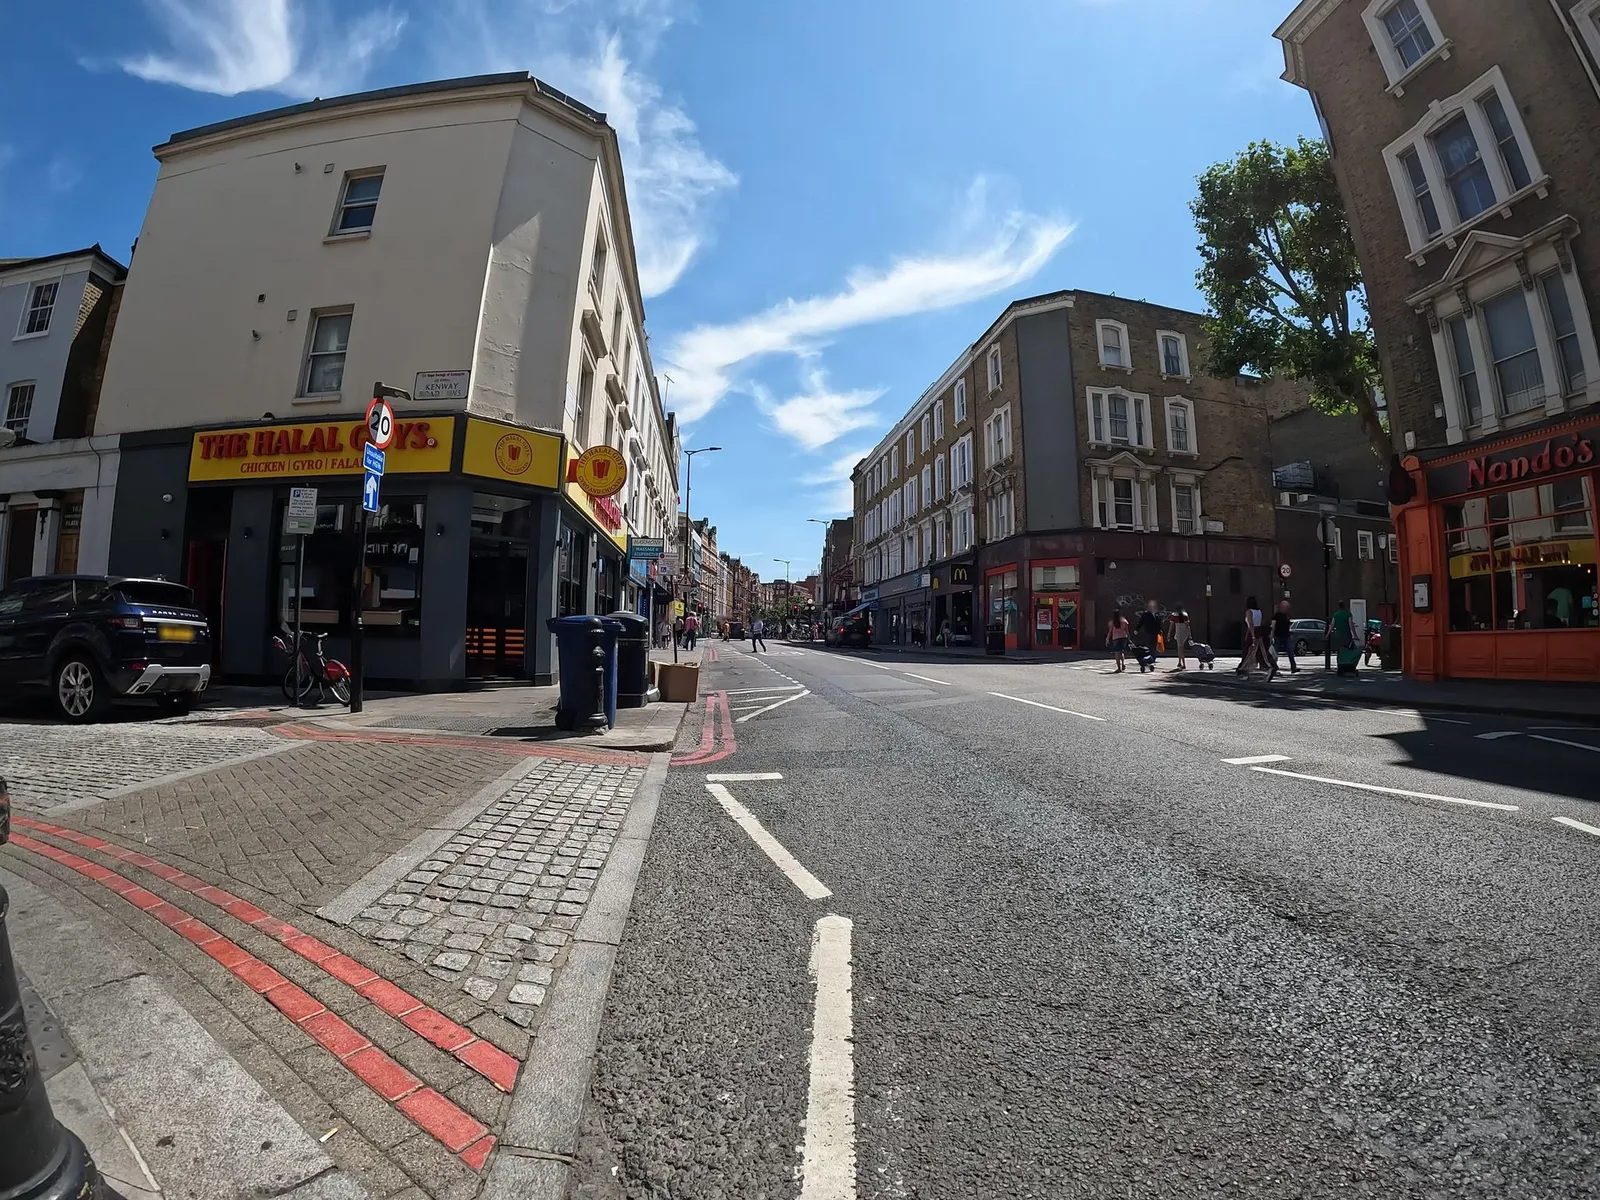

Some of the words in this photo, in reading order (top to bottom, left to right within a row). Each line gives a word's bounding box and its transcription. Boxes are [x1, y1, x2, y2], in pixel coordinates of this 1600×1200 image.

[425, 382, 459, 391] KENWAY
[370, 411, 390, 436] 20
[199, 432, 250, 460] THE
[252, 426, 344, 457] HALAL
[349, 421, 438, 452] GYS.
[240, 461, 285, 473] CHICKEN
[293, 459, 323, 471] GYRO
[579, 453, 589, 468] THE
[588, 447, 612, 457] HALAL
[613, 452, 625, 470] GUYS
[1466, 432, 1593, 488] Nando's
[578, 475, 589, 490] GYRO
[601, 477, 624, 494] CHICKEN
[1281, 566, 1291, 574] 20
